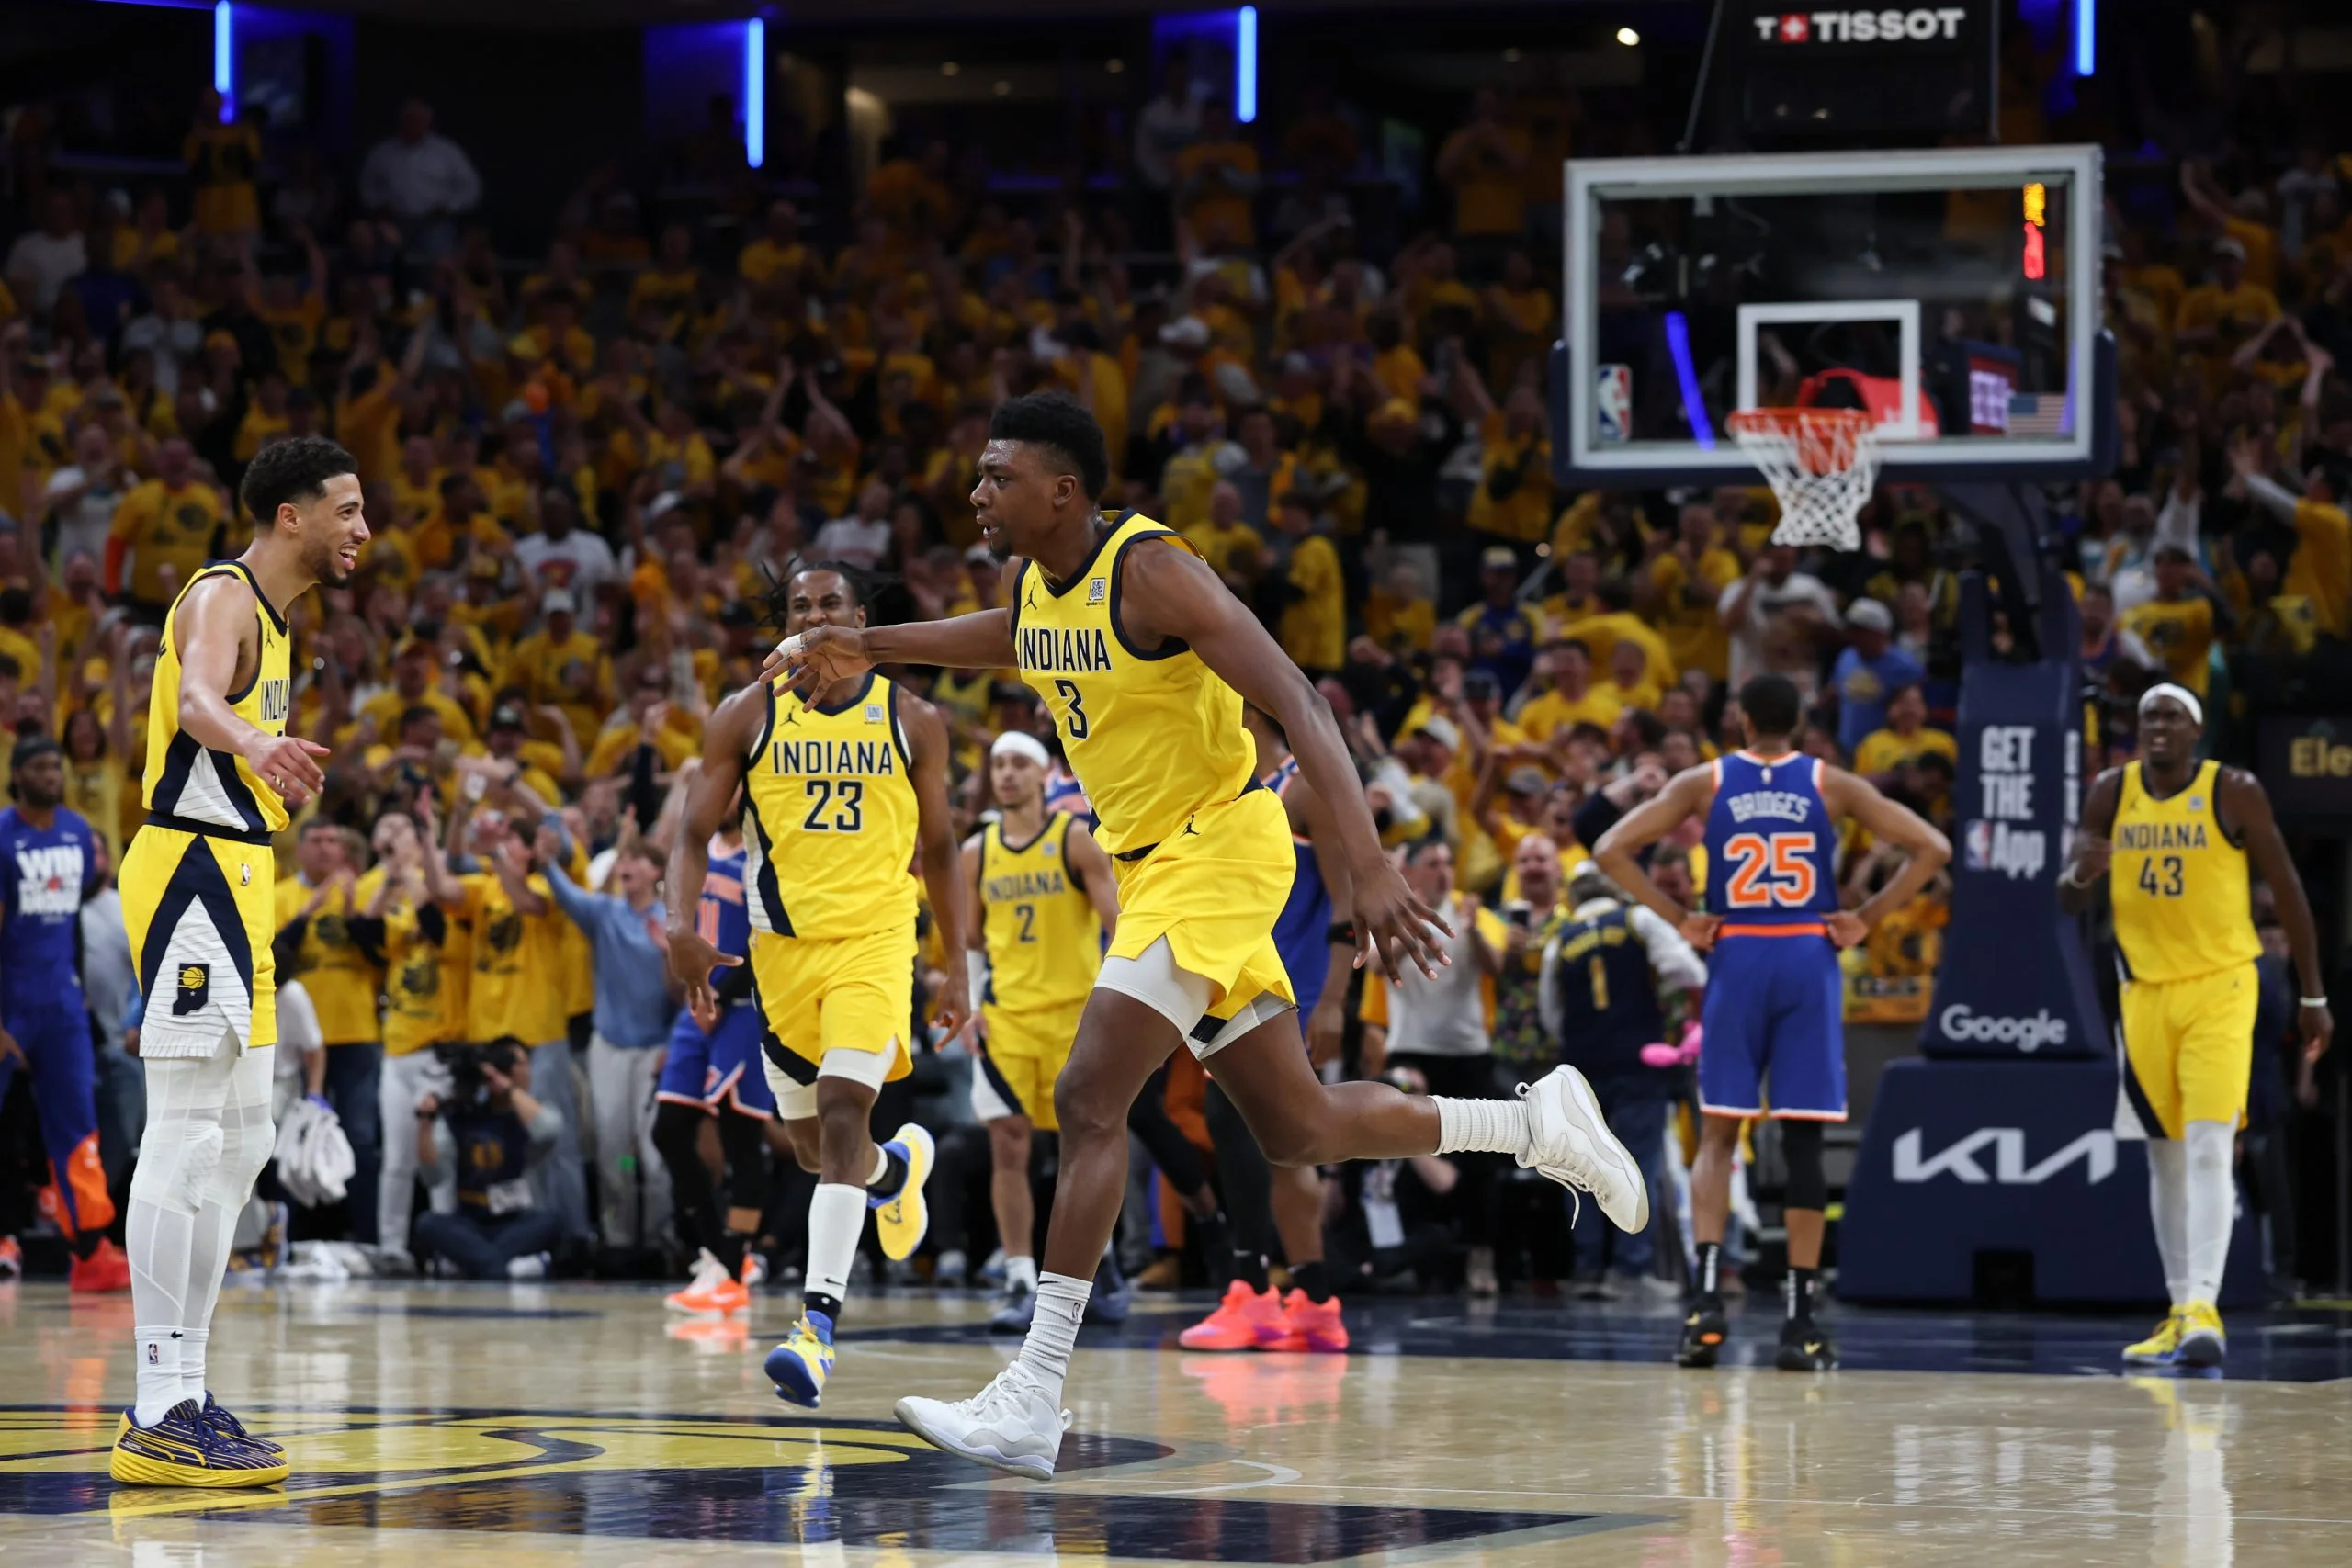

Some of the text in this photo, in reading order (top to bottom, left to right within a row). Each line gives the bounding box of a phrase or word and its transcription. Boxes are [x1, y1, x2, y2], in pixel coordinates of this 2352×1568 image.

[1812, 7, 1965, 43] TISSOT
[1018, 626, 1113, 672] INDIANA
[1054, 679, 1089, 739] 3
[773, 740, 894, 776] INDIANA
[1981, 725, 2036, 772] GET
[802, 779, 864, 833] 23
[1727, 790, 1812, 823] BRIDGES
[1979, 773, 2036, 820] THE
[1990, 820, 2046, 879] App
[2118, 822, 2209, 850] INDIANA
[985, 869, 1065, 903] INDIANA
[1723, 832, 1817, 908] 25
[2138, 855, 2183, 898] 43
[1014, 903, 1038, 944] 2
[1939, 1003, 2067, 1053] Google
[1893, 1126, 2116, 1185] KIA
